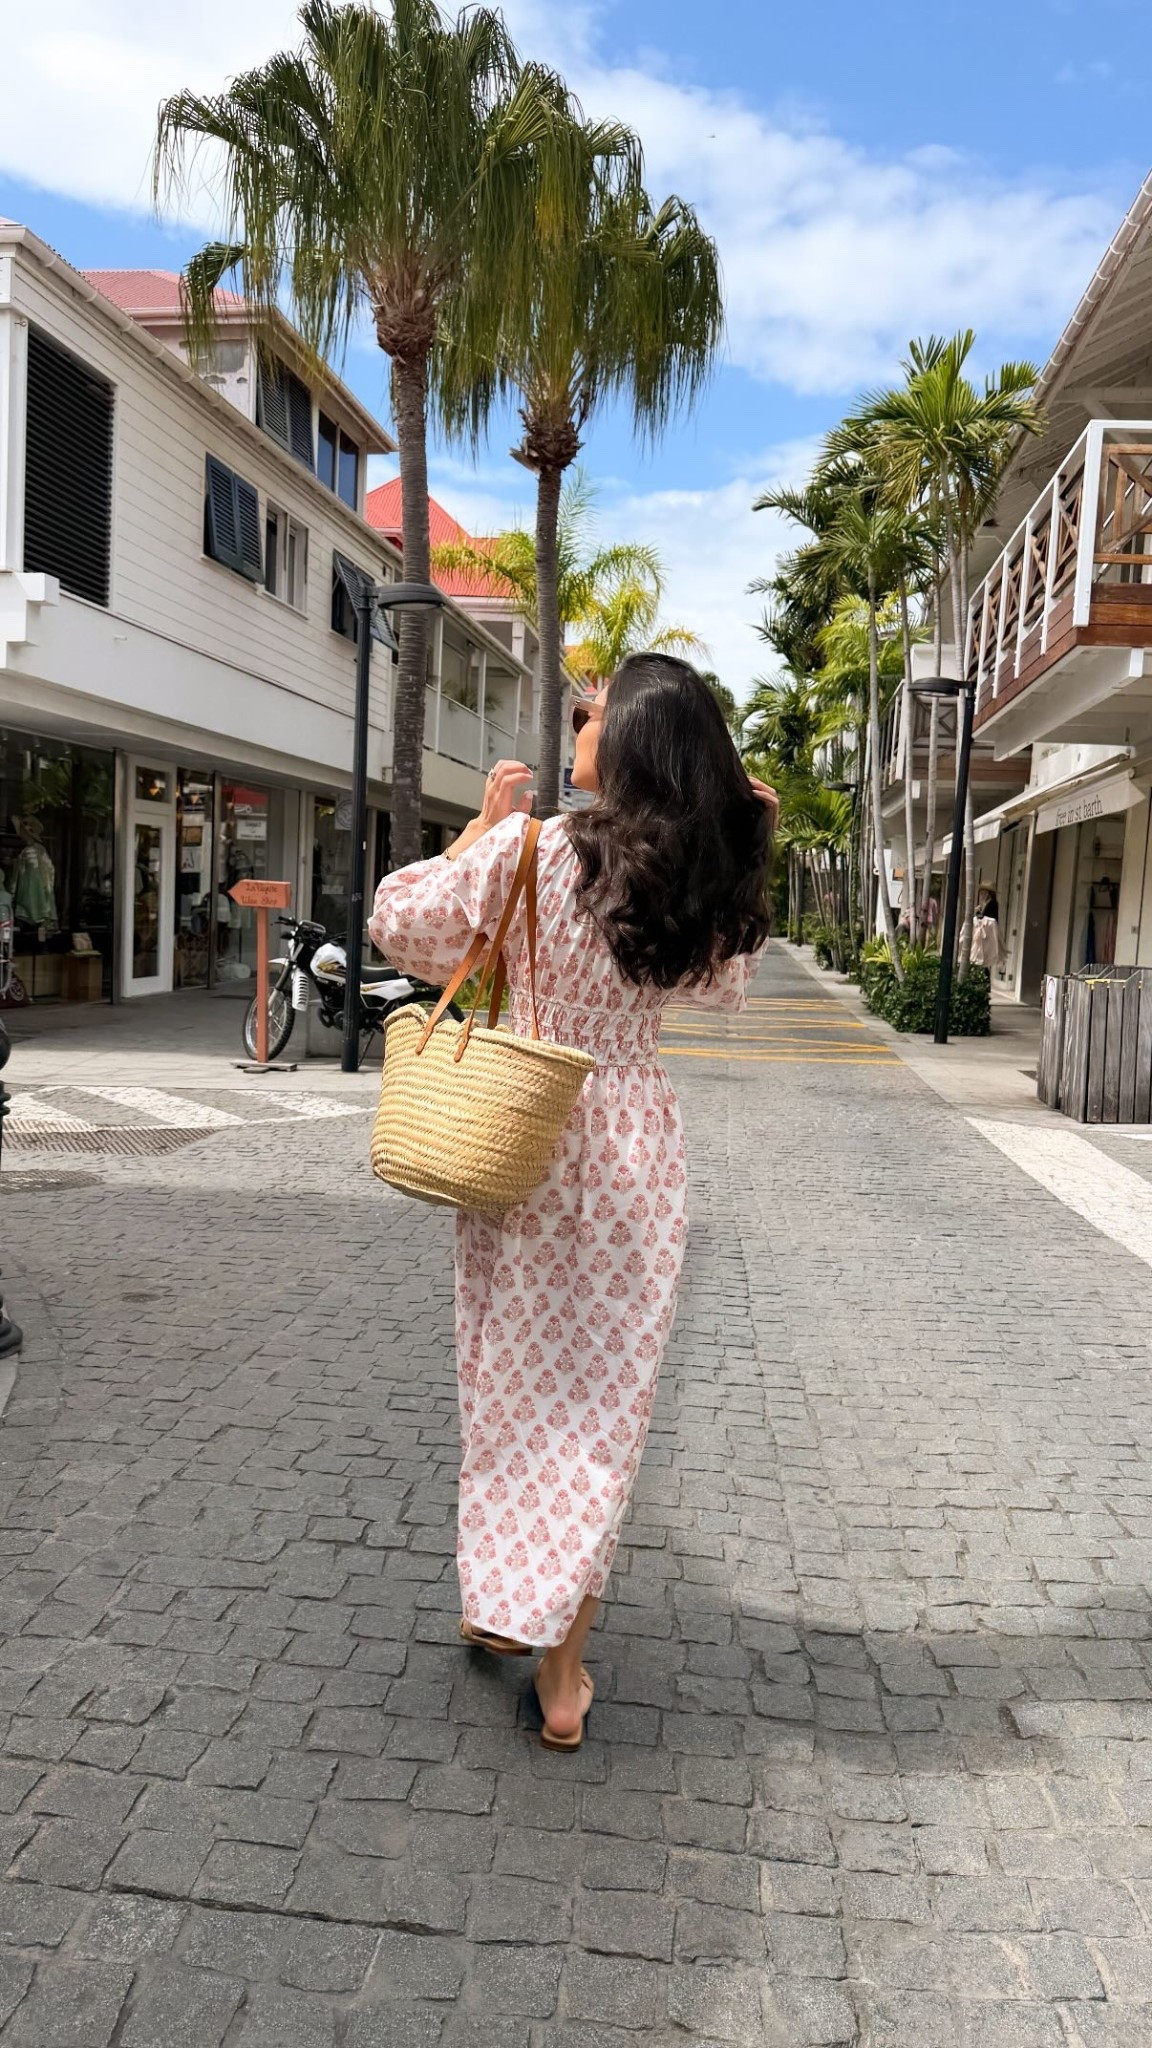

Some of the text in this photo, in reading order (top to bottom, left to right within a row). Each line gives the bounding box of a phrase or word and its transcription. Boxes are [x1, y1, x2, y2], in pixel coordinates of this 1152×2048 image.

[1054, 794, 1103, 827] free in st barth
